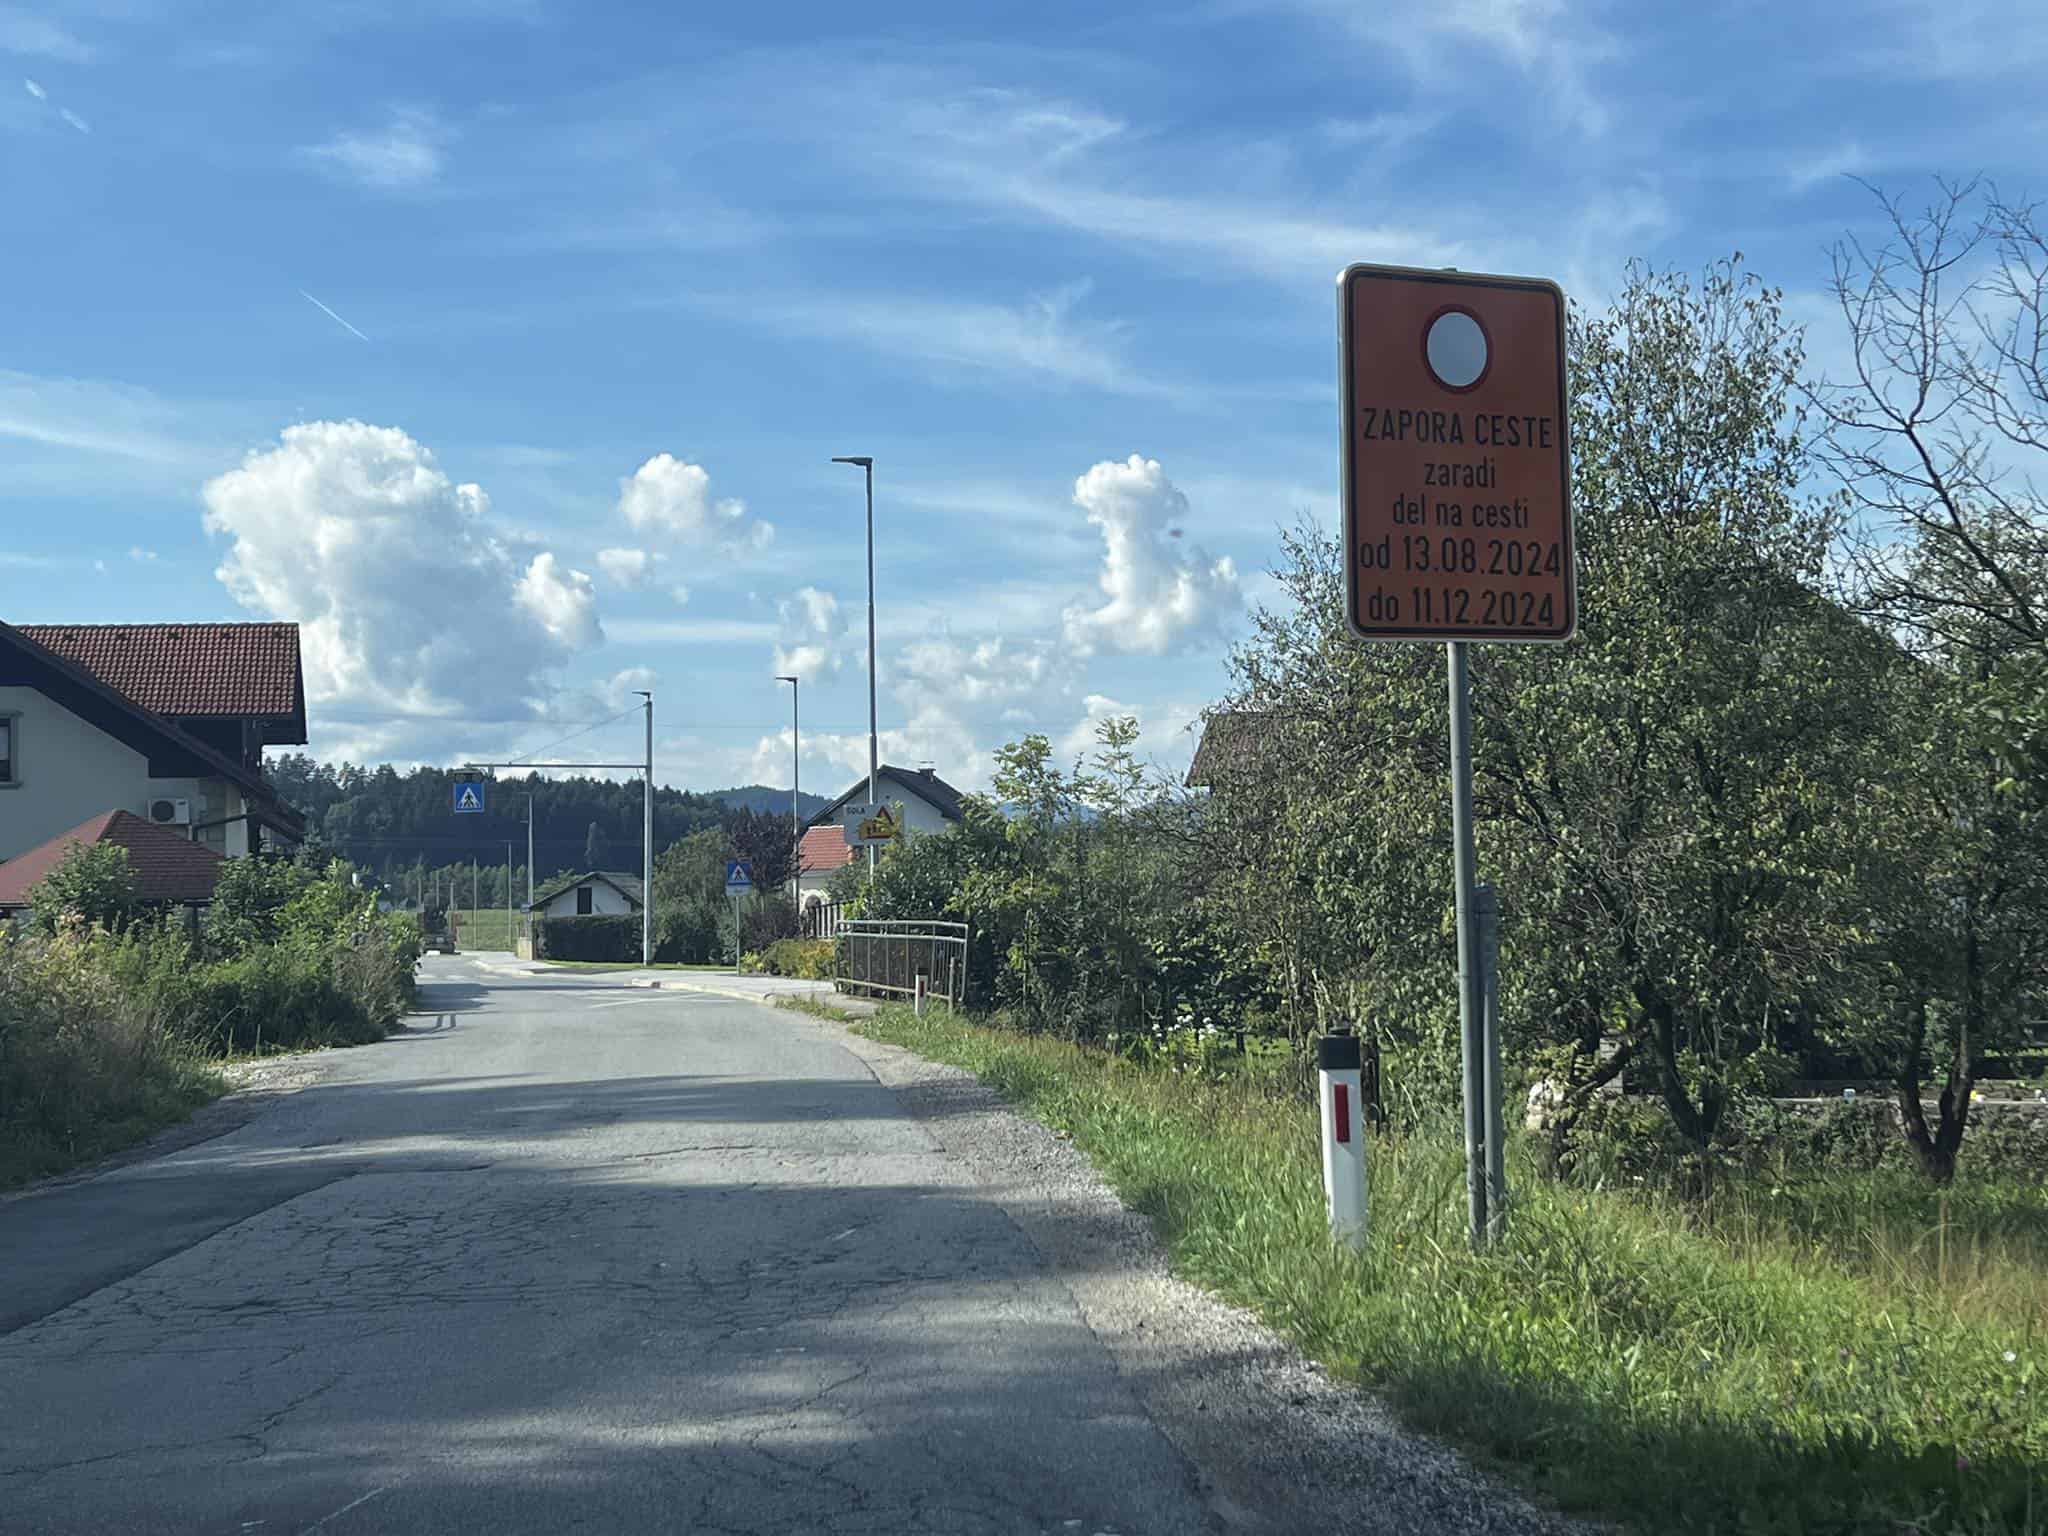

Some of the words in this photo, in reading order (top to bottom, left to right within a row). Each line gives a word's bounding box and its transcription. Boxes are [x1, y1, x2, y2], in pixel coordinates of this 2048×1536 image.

[1362, 407, 1465, 444] ZAPORA
[1474, 414, 1553, 449] CESTE
[1424, 455, 1496, 488] zaradi
[1392, 493, 1426, 526] del
[1435, 503, 1463, 527] na
[1472, 498, 1529, 529] cesti
[1359, 533, 1391, 569] od
[1403, 535, 1561, 577] 13.08.2024
[1368, 586, 1399, 621] do
[1412, 586, 1554, 627] 11.12.2024
